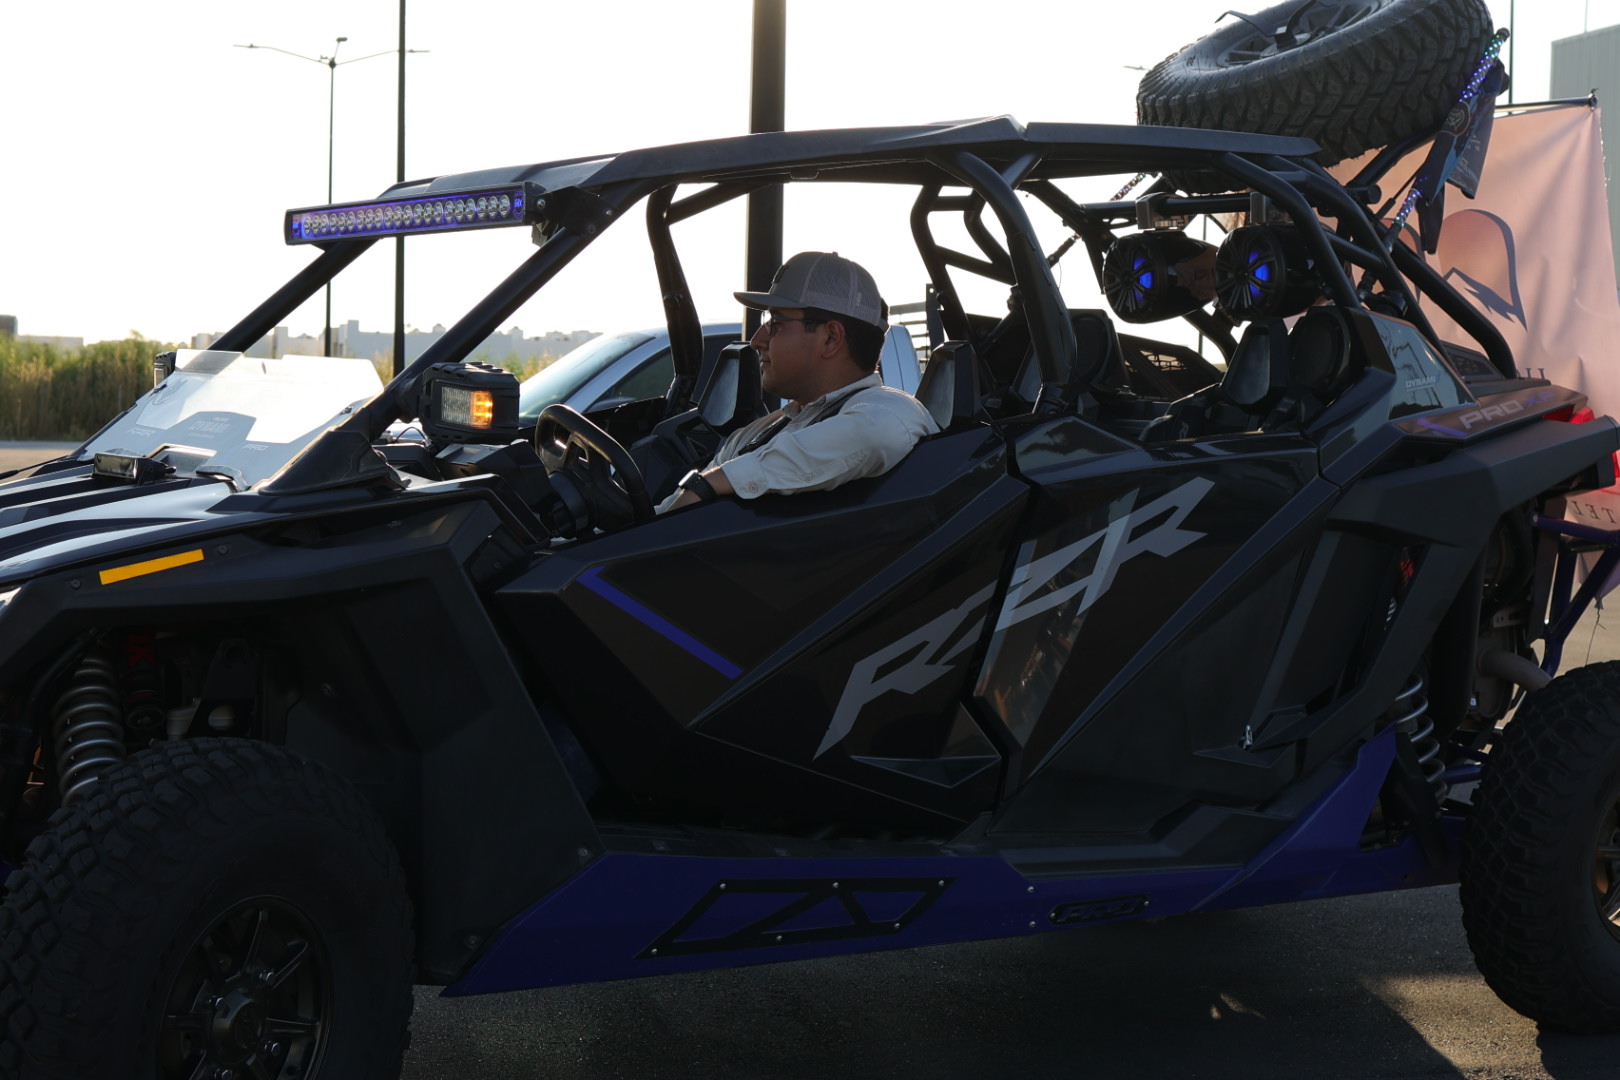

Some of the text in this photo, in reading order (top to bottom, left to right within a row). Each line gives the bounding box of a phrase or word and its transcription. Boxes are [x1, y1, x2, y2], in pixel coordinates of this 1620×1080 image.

[1459, 391, 1556, 430] PRO XP
[813, 476, 1215, 761] RZR
